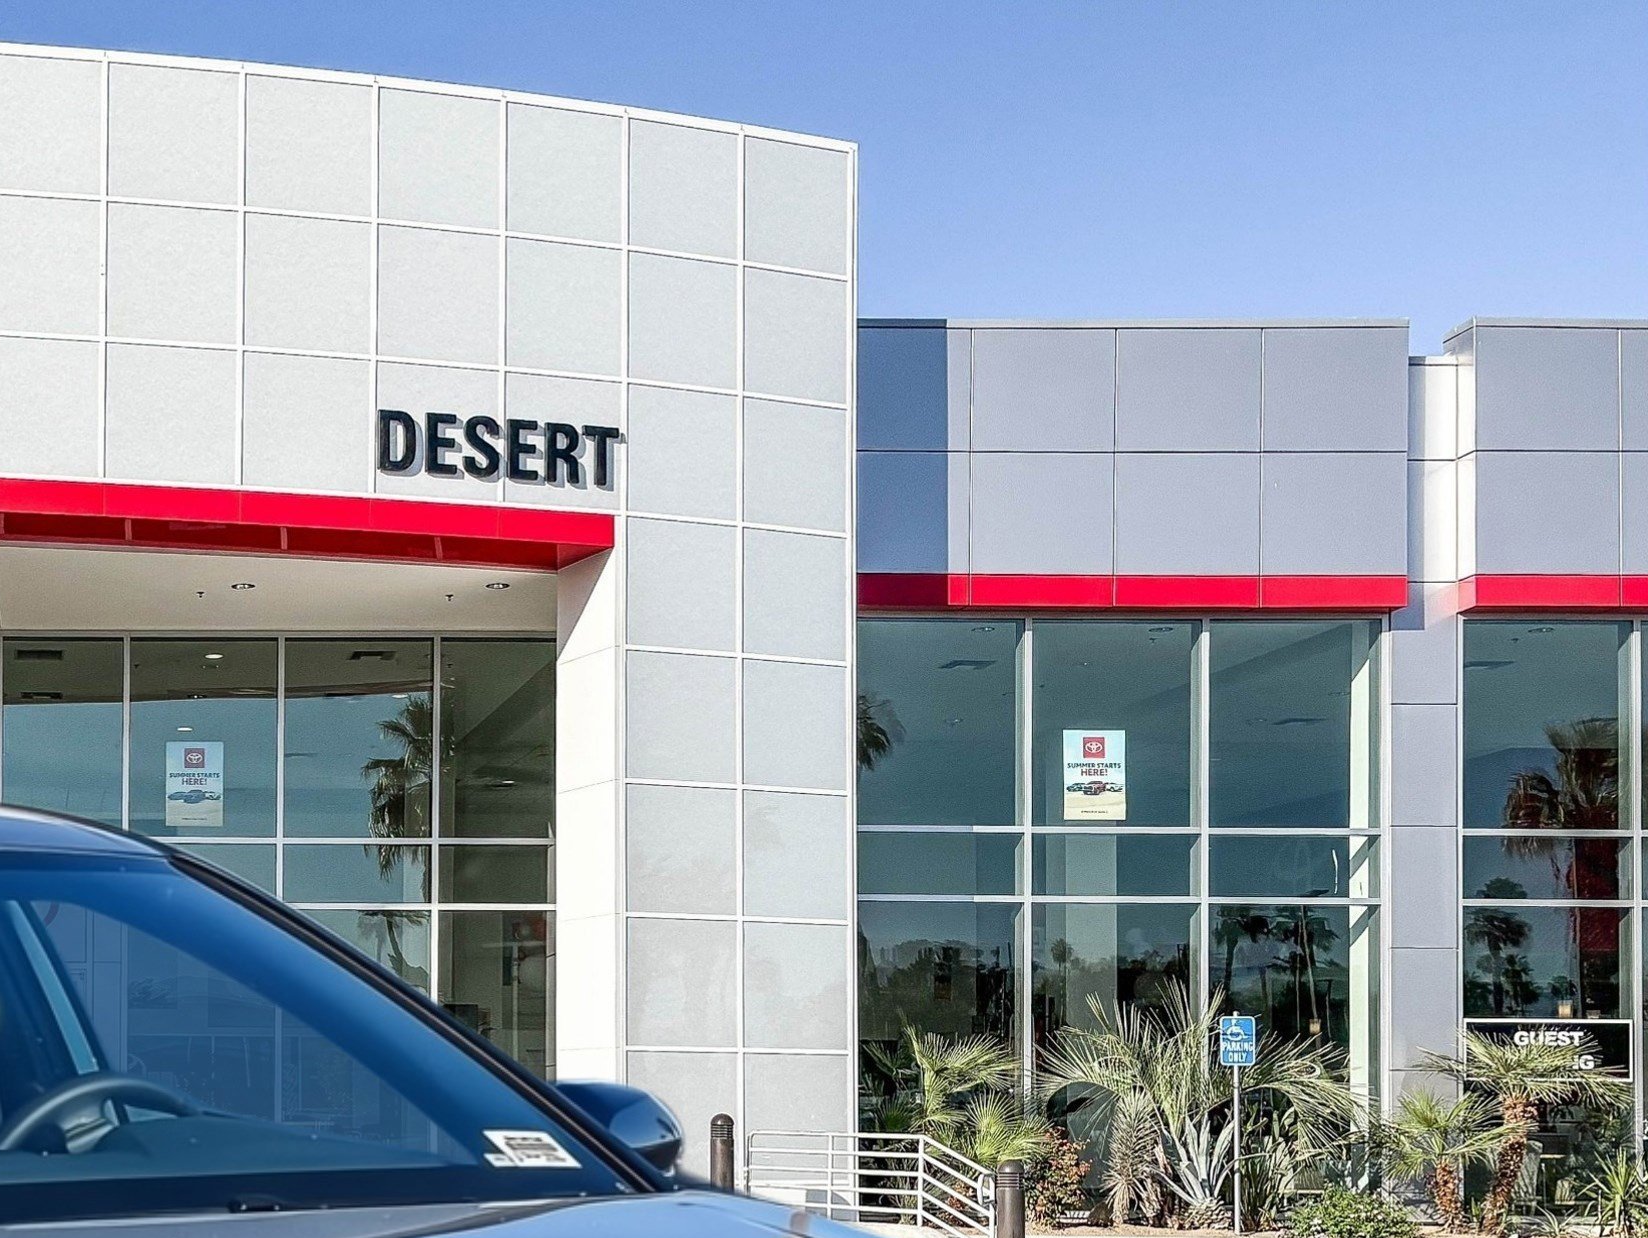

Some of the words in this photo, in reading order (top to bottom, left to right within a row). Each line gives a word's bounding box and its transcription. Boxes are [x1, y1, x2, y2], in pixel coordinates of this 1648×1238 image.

[377, 409, 620, 486] DESERT
[181, 778, 207, 786] HERE!
[1513, 1030, 1584, 1047] GUEST
[1222, 1041, 1254, 1051] PARKING
[1228, 1052, 1247, 1062] ONLY
